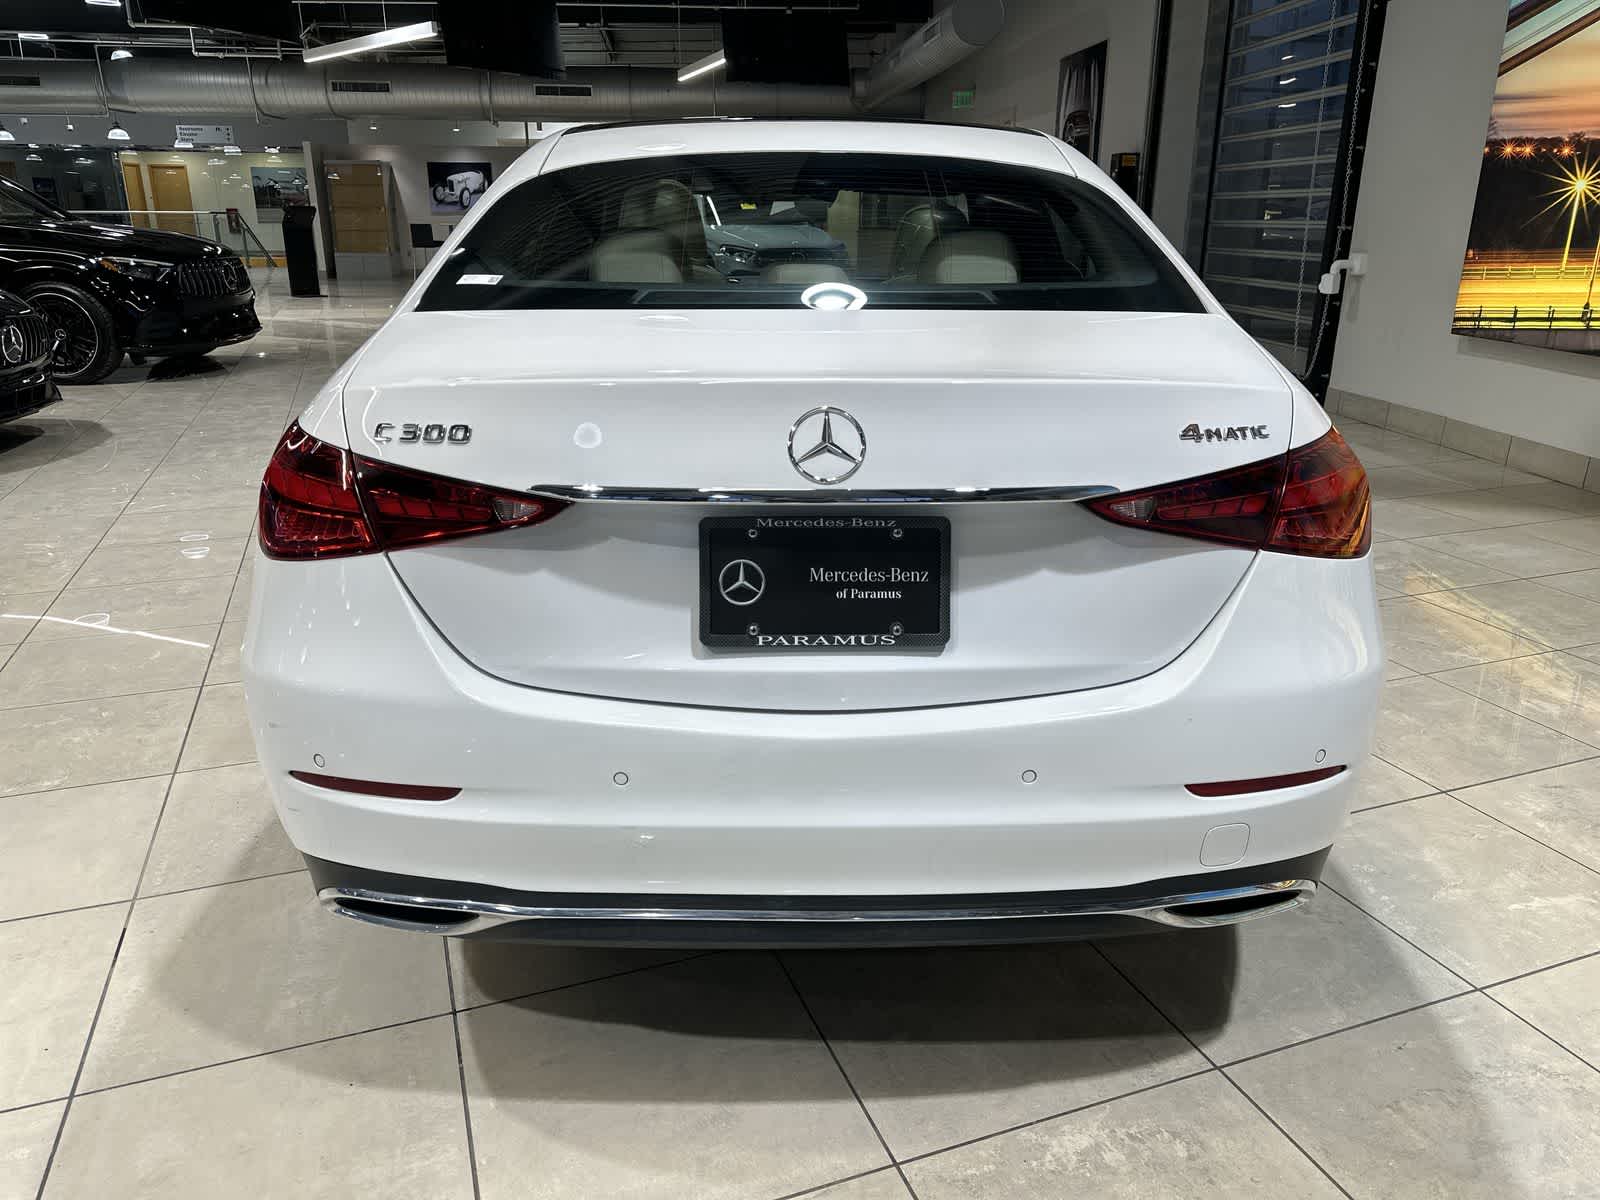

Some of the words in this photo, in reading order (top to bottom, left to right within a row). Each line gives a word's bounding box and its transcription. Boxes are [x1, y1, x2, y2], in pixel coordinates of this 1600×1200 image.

[374, 422, 395, 442] C
[399, 423, 472, 444] 300
[1179, 423, 1271, 443] 4MATIC
[756, 517, 897, 528] Mercedes-Benz
[809, 567, 929, 583] Mercedes-Benz
[836, 588, 848, 599] of
[850, 588, 902, 599] Paramus
[756, 635, 896, 646] PARAMUS
